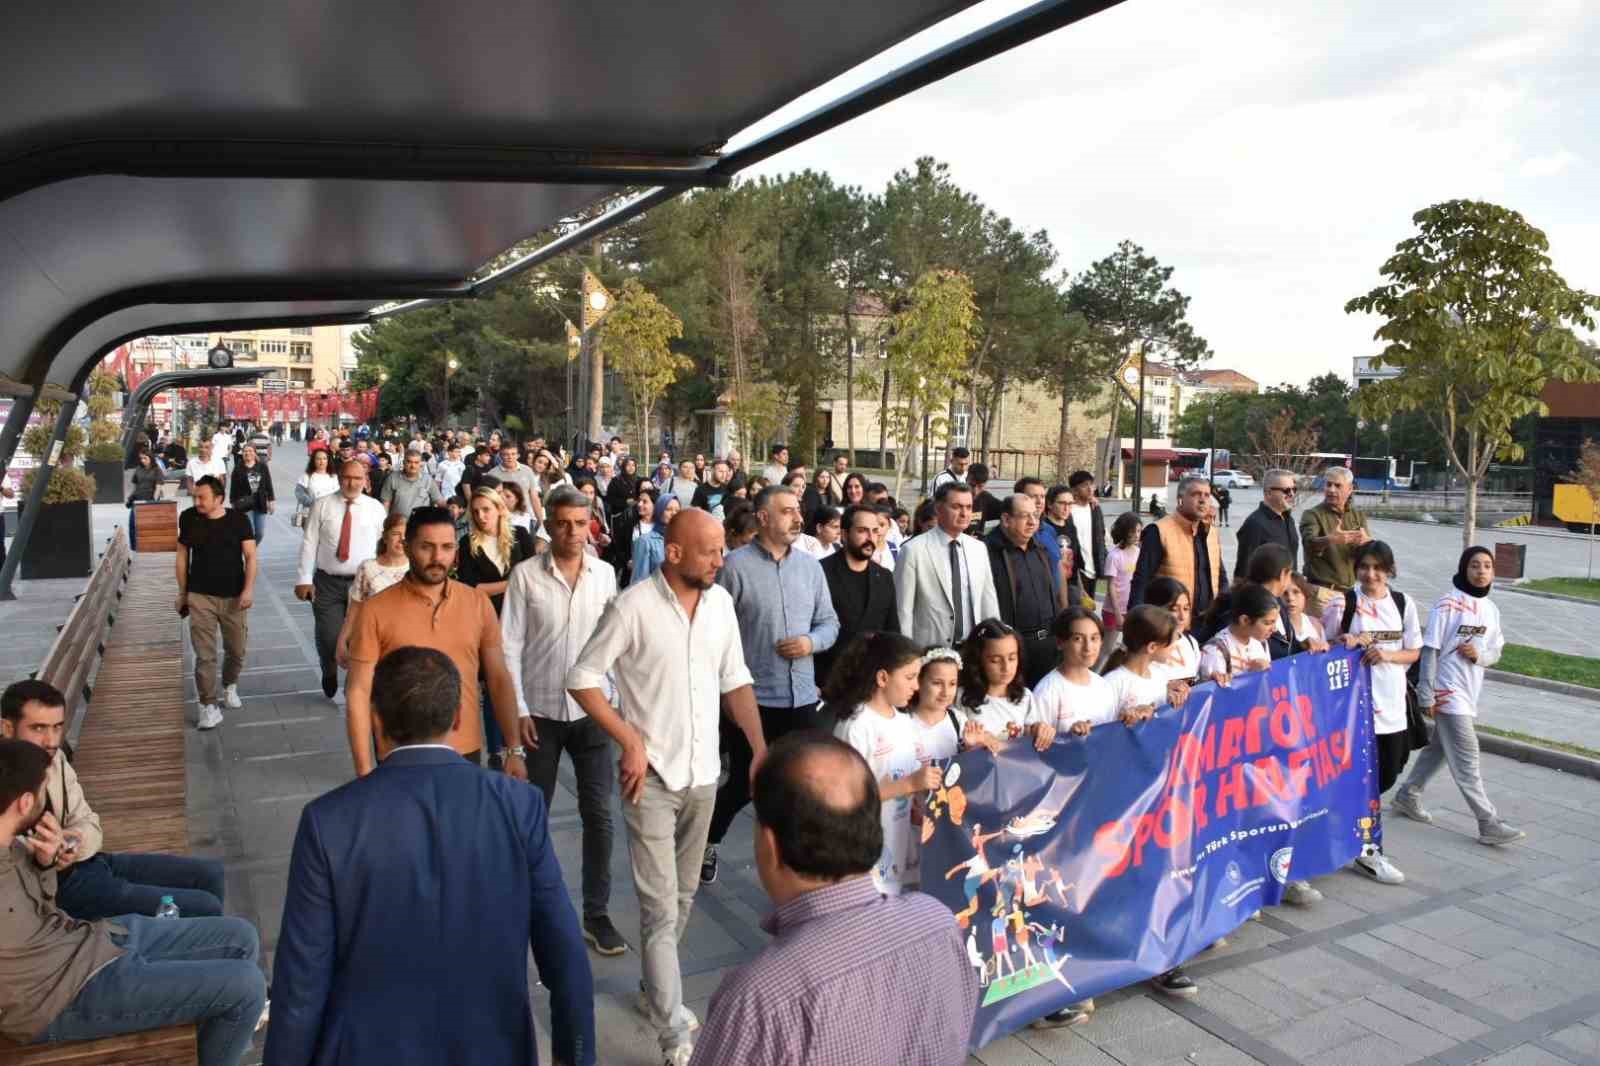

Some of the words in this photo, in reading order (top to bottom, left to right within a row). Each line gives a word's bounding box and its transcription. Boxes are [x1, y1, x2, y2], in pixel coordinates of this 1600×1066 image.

[1327, 659, 1341, 676] 07
[1329, 675, 1342, 690] 11
[1205, 836, 1228, 854] Türk
